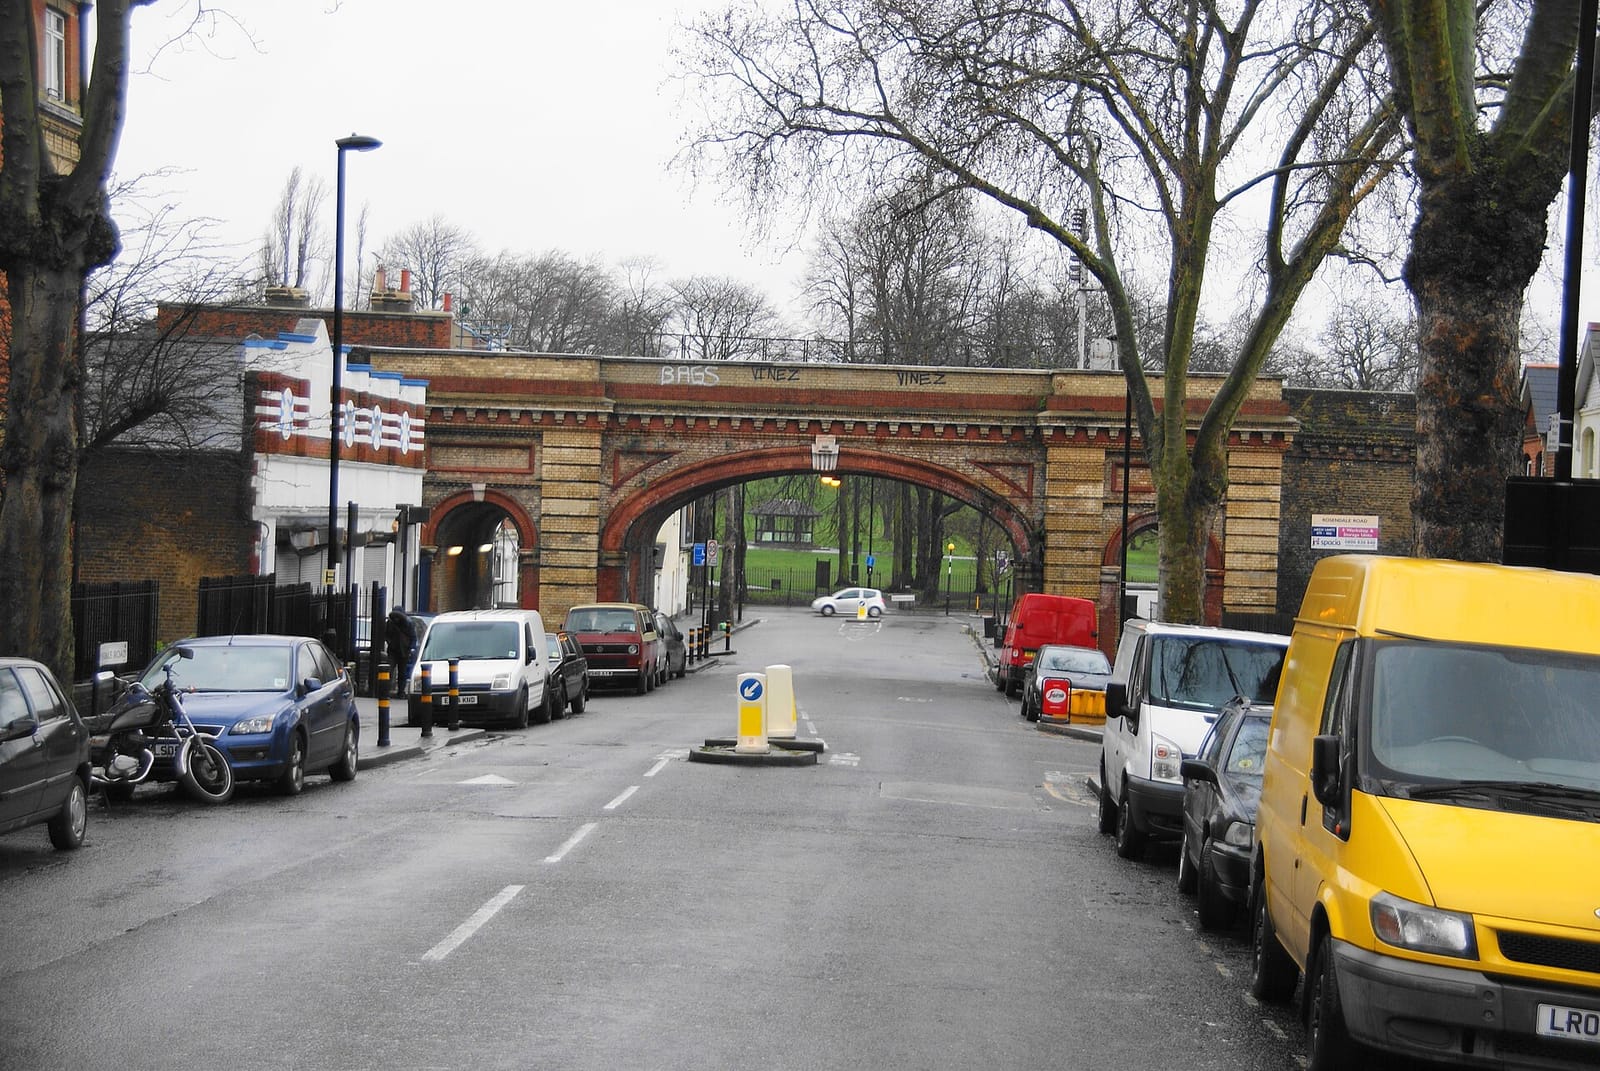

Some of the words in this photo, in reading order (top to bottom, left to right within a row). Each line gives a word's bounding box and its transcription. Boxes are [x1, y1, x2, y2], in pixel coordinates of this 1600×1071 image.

[660, 365, 720, 386] BAGS
[751, 366, 801, 381] VINEZ
[896, 371, 947, 386] VINEZ
